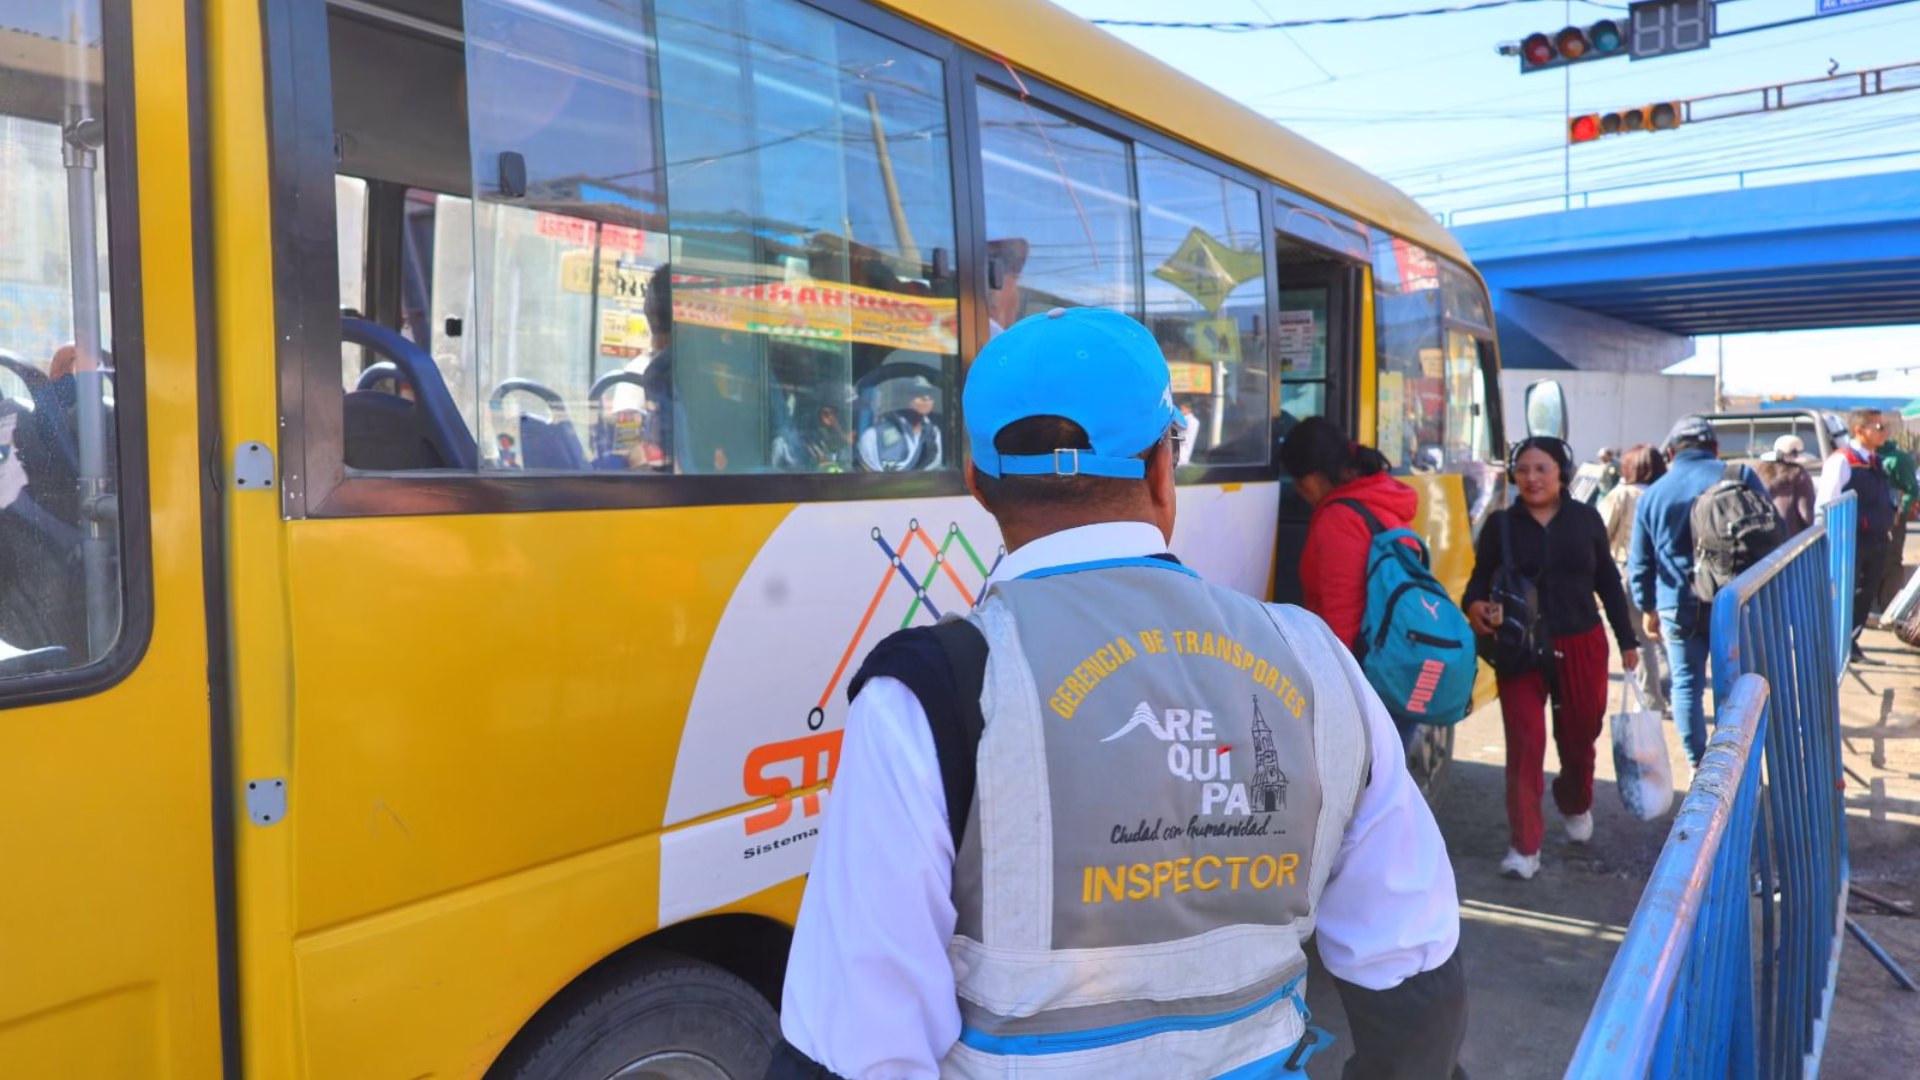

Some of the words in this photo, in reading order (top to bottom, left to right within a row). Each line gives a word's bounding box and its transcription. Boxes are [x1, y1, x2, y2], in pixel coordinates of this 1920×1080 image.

[1050, 636, 1138, 720] GERENCIA
[1139, 629, 1168, 655] DE
[1173, 630, 1306, 720] TRANSPORTES
[1406, 659, 1445, 713] PUMA
[1201, 782, 1251, 816] PA
[743, 827, 819, 859] Sistema
[1110, 817, 1162, 844] Ciudad
[1163, 826, 1184, 841] con
[1081, 853, 1299, 903] INSPECTOR
